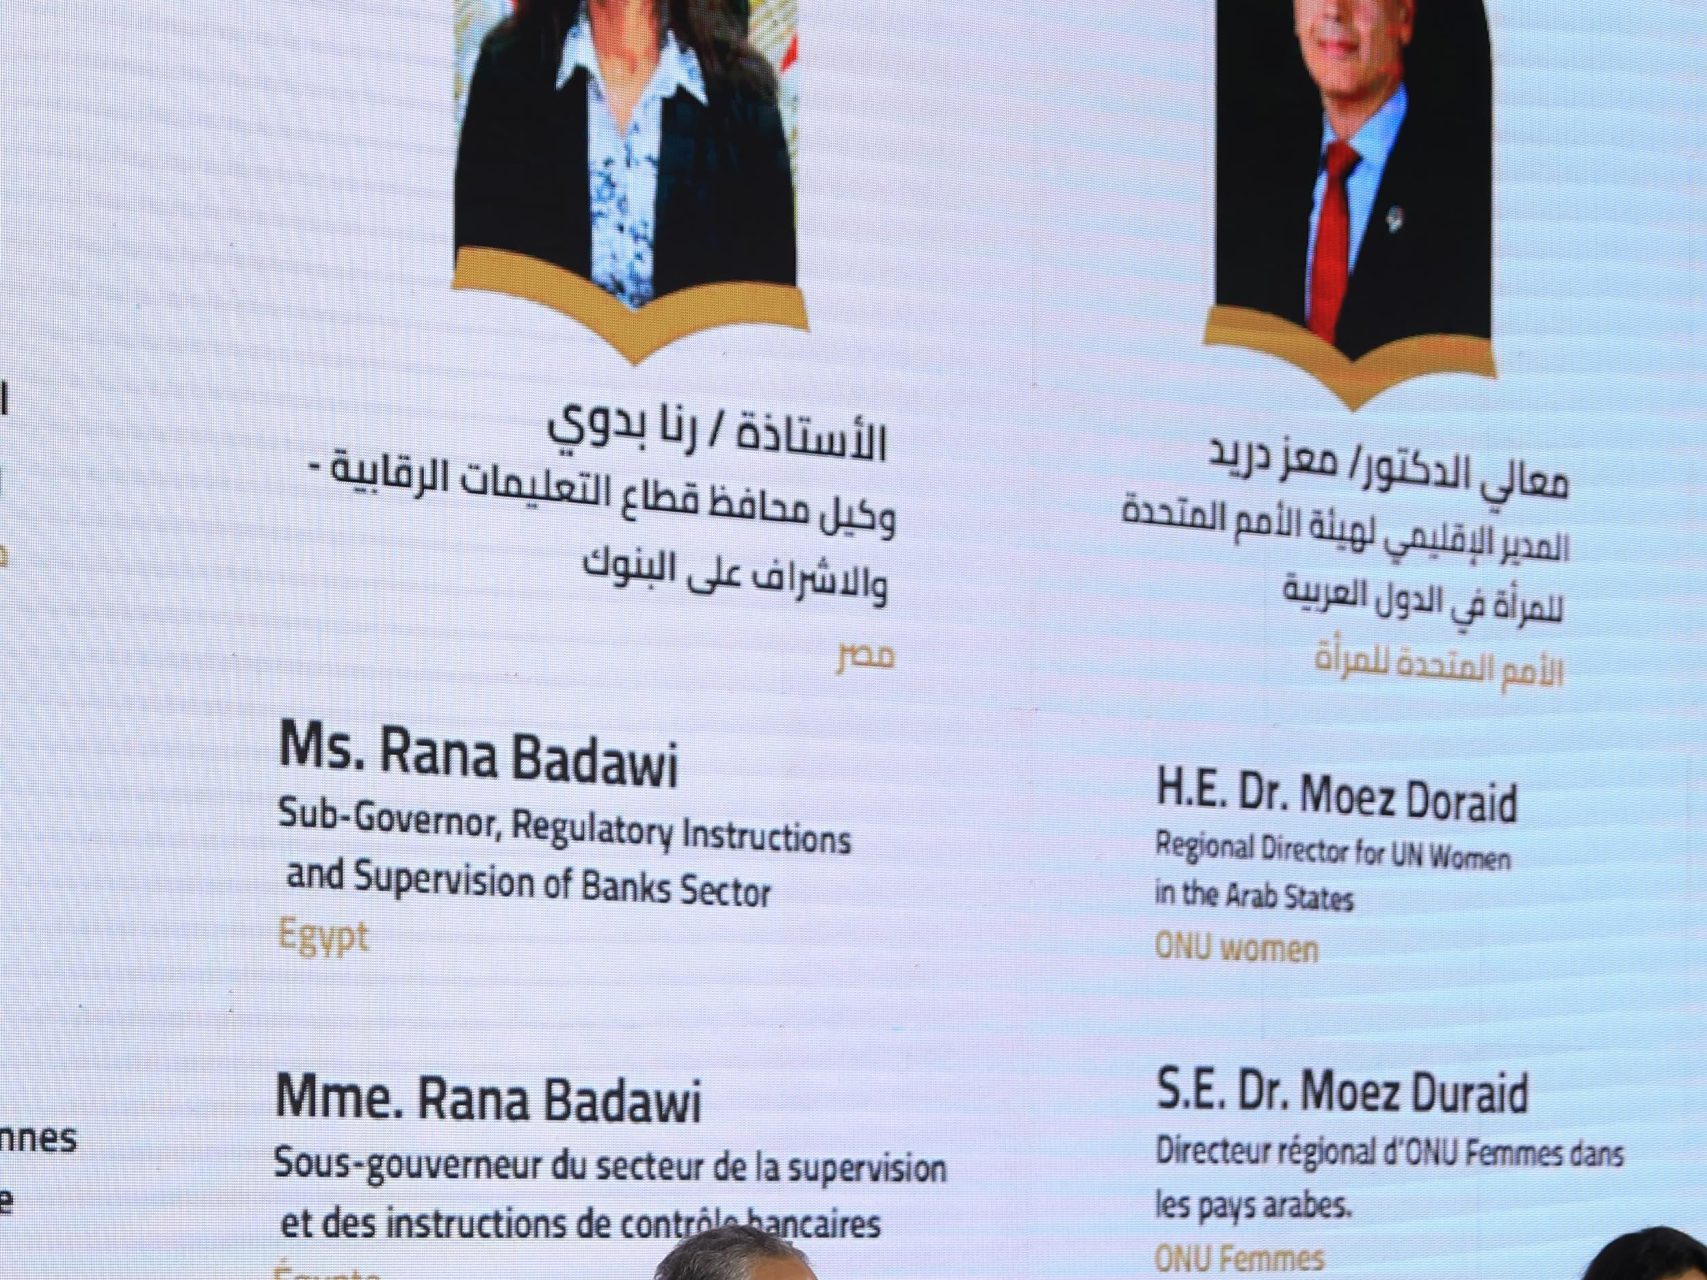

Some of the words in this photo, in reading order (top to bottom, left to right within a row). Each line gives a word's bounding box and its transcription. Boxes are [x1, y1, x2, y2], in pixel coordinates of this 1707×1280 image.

[547, 403, 646, 457] بدوي
[660, 403, 697, 457] رنا
[737, 411, 887, 462] الأستاذة
[330, 448, 449, 500] الرقابية
[1210, 438, 1272, 480] دريد
[1279, 436, 1338, 483] معز
[460, 464, 611, 509] التعليمات
[621, 478, 699, 523] قطاع
[708, 485, 810, 525] محافظ
[1480, 460, 1569, 514] معالي
[819, 496, 896, 542] وكيل
[1122, 493, 1226, 531] المتحدة
[1234, 501, 1301, 545] الأمم
[1309, 507, 1376, 554] لهيئة
[1383, 523, 1494, 566] الإقليمي
[1500, 534, 1569, 566] المدير
[582, 545, 676, 589] البنوك
[686, 556, 741, 596] على
[751, 557, 888, 610] والاشراف
[1283, 573, 1367, 613] العربية
[1375, 583, 1443, 621] الدول
[1451, 595, 1486, 635] في
[1494, 581, 1563, 630] للمرأة
[836, 643, 896, 675] مصر
[1315, 631, 1390, 681] للمرأة
[1396, 648, 1494, 682] المتحدة
[1501, 653, 1564, 694] الأمم
[280, 718, 364, 770] Ms.
[381, 724, 498, 779] Rana
[513, 733, 677, 788] Badawi
[1158, 765, 1227, 808] H.E.
[1240, 770, 1288, 810] Dr.
[1301, 773, 1396, 817] Moez
[1407, 779, 1517, 824] Doraid
[278, 794, 502, 842] Sub-Governor,
[512, 808, 674, 855] Regulatory
[683, 817, 852, 855] Instructions
[1156, 828, 1255, 866] Regional
[1262, 833, 1350, 864] Director
[1355, 838, 1386, 866] for
[1392, 842, 1424, 867] UN
[1430, 844, 1511, 871] Women
[287, 857, 344, 890] and
[354, 857, 535, 901] Supervision
[544, 866, 573, 899] of
[582, 868, 672, 904] Banks
[681, 872, 772, 908] Sector
[1155, 879, 1176, 904] in
[1182, 880, 1219, 907] the
[1226, 882, 1278, 909] Arab
[1285, 884, 1355, 913] States
[278, 916, 369, 959] Egypt
[1155, 929, 1212, 961] ONU
[1221, 939, 1319, 963] women
[277, 1071, 403, 1120] Mme.
[419, 1075, 530, 1122] Rana
[545, 1077, 701, 1124] Badawi
[1158, 1064, 1225, 1110] S.E.
[1239, 1067, 1289, 1110] Dr.
[1302, 1068, 1401, 1112] Moez
[1412, 1071, 1528, 1114] Duraid
[274, 1144, 543, 1189] Sous-gouverneur
[551, 1147, 587, 1180] du
[596, 1152, 704, 1181] secteur
[714, 1150, 747, 1182] de
[756, 1150, 781, 1182] la
[788, 1152, 947, 1190] supervision
[1157, 1134, 1272, 1165] Directeur
[1278, 1134, 1377, 1174] régional
[1466, 1137, 1564, 1167] Femmes
[1570, 1141, 1625, 1168] dans
[281, 1209, 313, 1238] et
[322, 1205, 376, 1239] des
[387, 1206, 567, 1239] instructions
[576, 1206, 611, 1239] de
[749, 1206, 881, 1239] bancaires
[1156, 1189, 1191, 1219] les
[1199, 1196, 1256, 1226] pays
[1263, 1189, 1352, 1219] arabes.
[1154, 1243, 1212, 1273] ONU
[1220, 1243, 1326, 1273] Femmes
